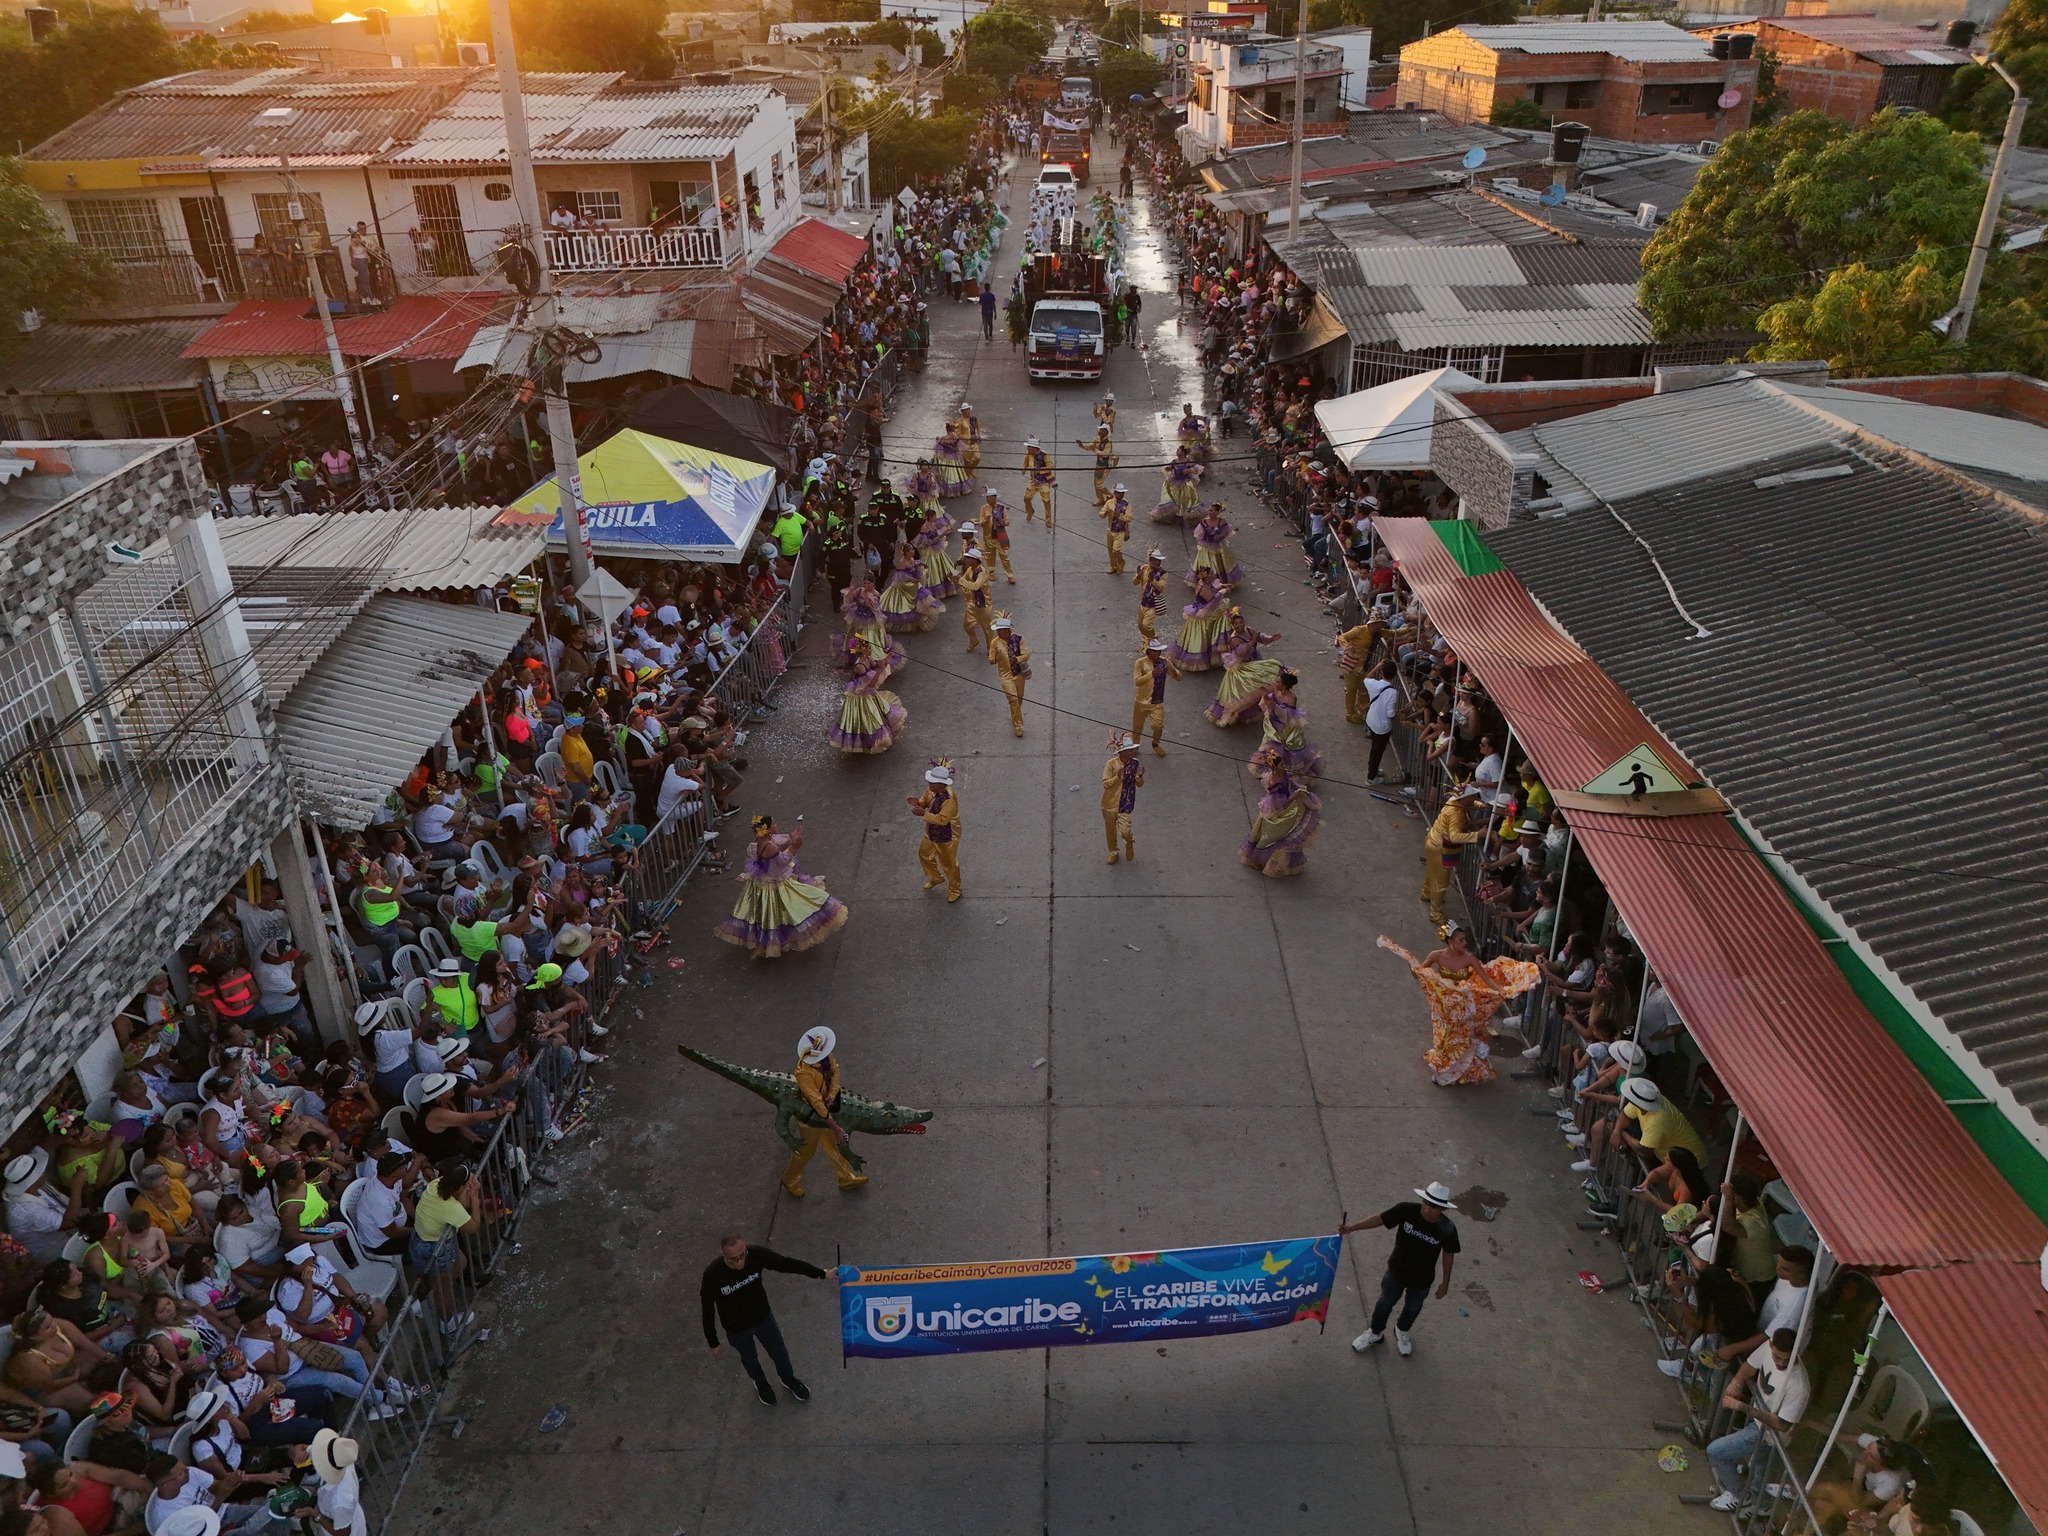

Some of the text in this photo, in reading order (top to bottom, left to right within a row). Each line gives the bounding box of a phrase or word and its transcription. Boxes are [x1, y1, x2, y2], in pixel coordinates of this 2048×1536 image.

[556, 503, 658, 531] GUILA
[864, 1259, 1073, 1283] #UnicaribeCaimányCarnaval2026
[1102, 1282, 1319, 1313] LA TRANSFORMACIÓN
[1115, 1278, 1266, 1299] EL CARIBE VIVE
[916, 1297, 1082, 1332] unicaribe
[1112, 1316, 1198, 1329] www.unicaribe.edu.co
[917, 1323, 1050, 1338] INSTITUCIÓN UNIVERSITARIA DEL CARIBE
